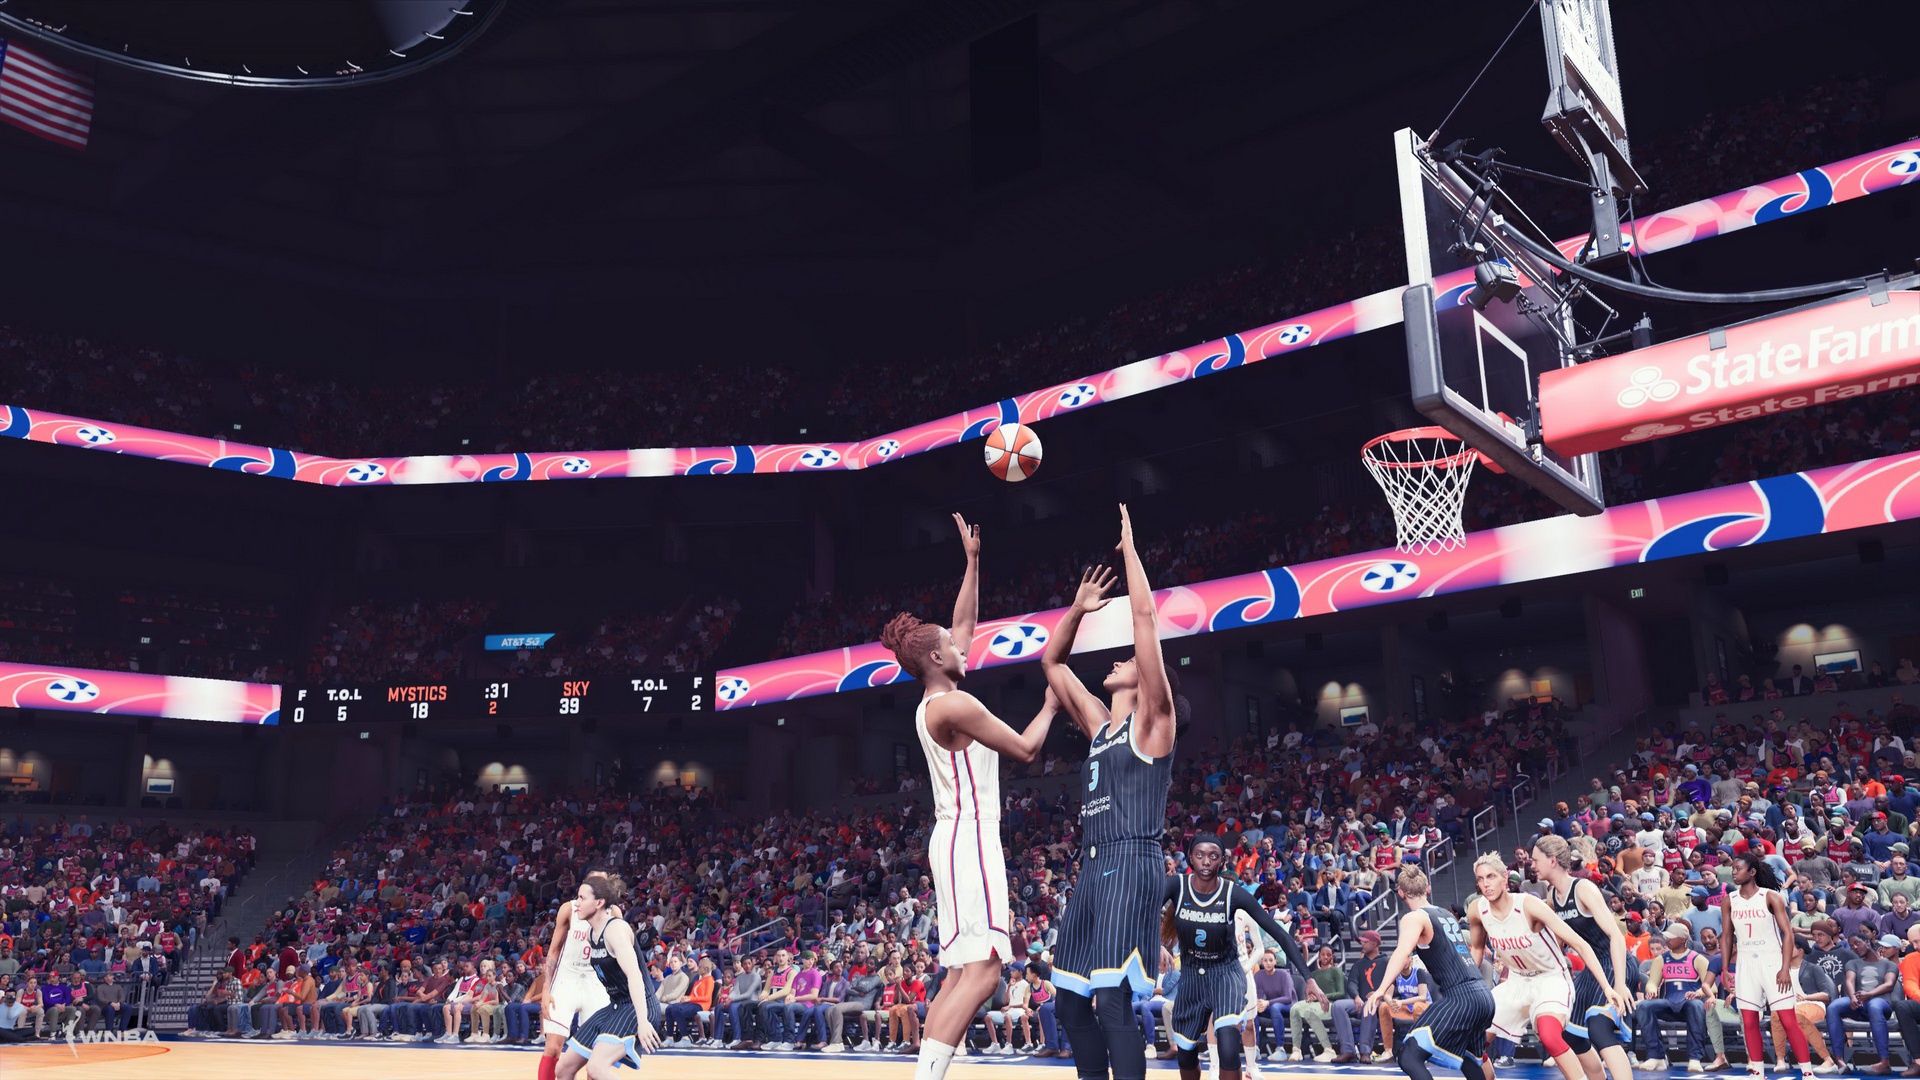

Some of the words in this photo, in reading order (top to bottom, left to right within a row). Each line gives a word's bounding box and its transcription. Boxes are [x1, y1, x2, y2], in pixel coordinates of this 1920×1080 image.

[501, 638, 524, 647] AT&T
[563, 681, 590, 696] SKY
[631, 679, 668, 691] T.O.L
[693, 677, 702, 688] F
[298, 690, 307, 701] F
[327, 689, 362, 701] T.O.L
[388, 685, 448, 702] MYSTICS
[484, 683, 509, 699] :31
[489, 701, 497, 714] 2
[559, 698, 580, 714] 39
[642, 696, 652, 712] 7
[691, 695, 701, 711] 2
[293, 707, 304, 723] 0
[337, 706, 347, 721] 5
[410, 703, 429, 719] 18
[1089, 760, 1099, 791] 3
[1437, 916, 1464, 942] 22
[1744, 923, 1752, 938] 7
[1195, 929, 1207, 947] 2
[583, 946, 592, 960] 9
[1511, 955, 1528, 970] 11
[1666, 966, 1691, 975] RISE
